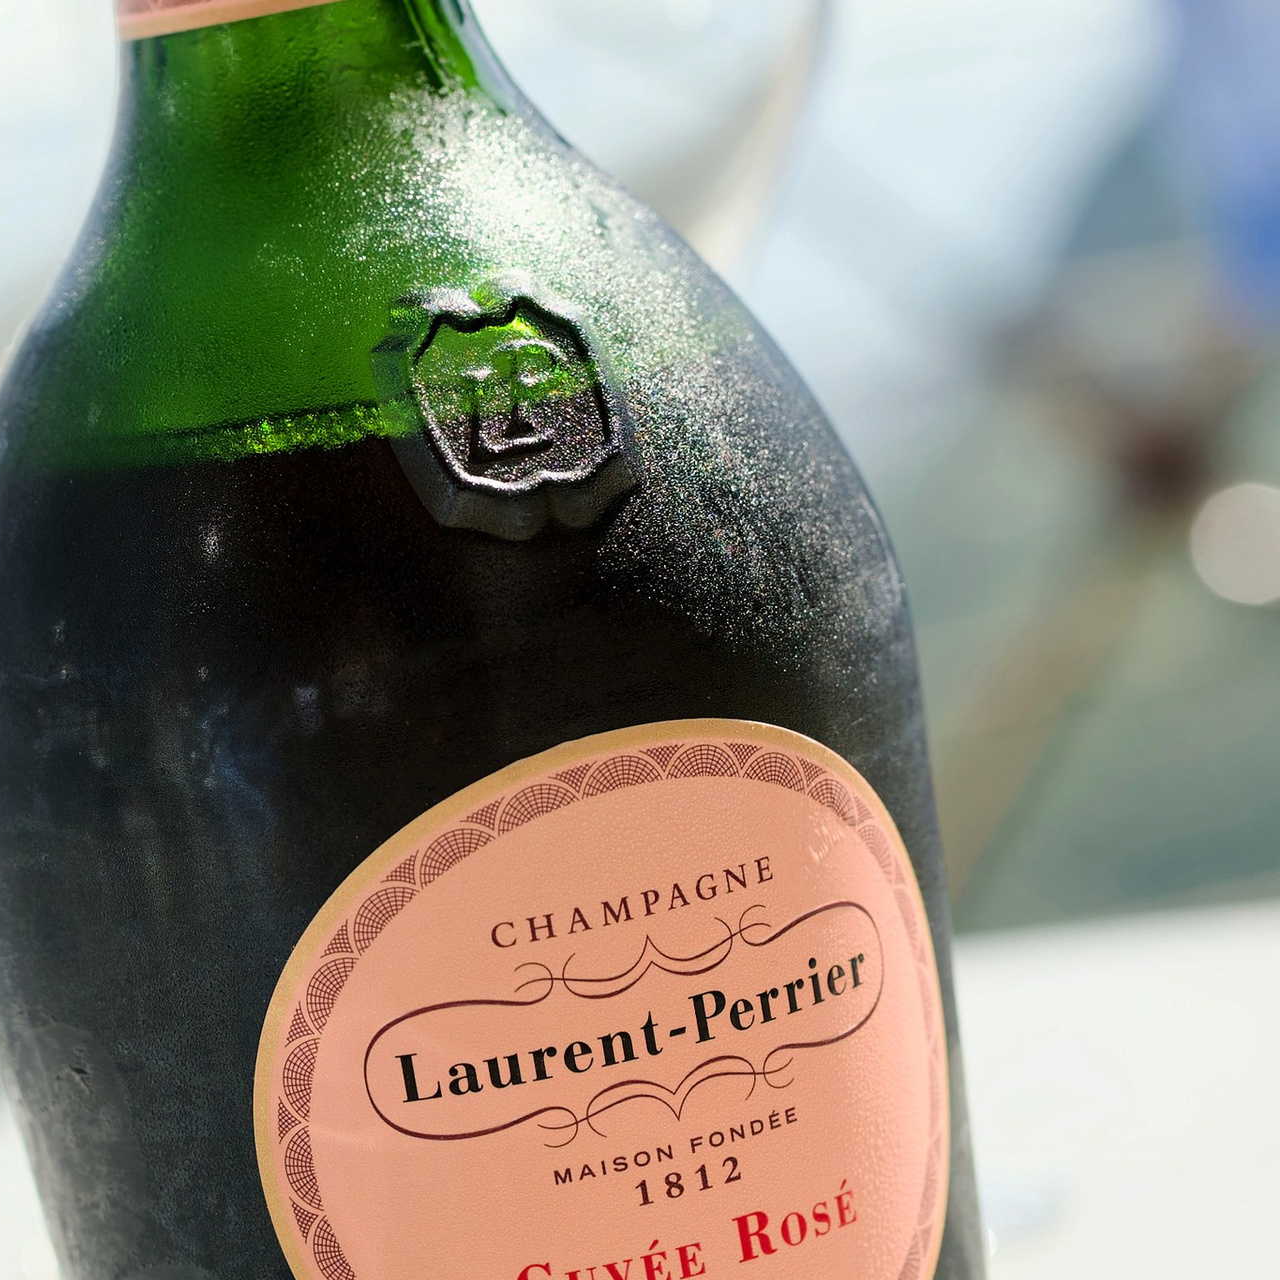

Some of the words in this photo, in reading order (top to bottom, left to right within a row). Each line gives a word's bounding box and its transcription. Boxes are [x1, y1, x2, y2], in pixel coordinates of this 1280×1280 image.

[491, 856, 774, 949] CHAMPAGNE
[395, 951, 866, 1104] Laurent-Perrier
[553, 1145, 674, 1186] MAISON
[689, 1106, 799, 1154] FONDÉE
[635, 1156, 742, 1206] 1812
[732, 1180, 858, 1263] ROSÉ
